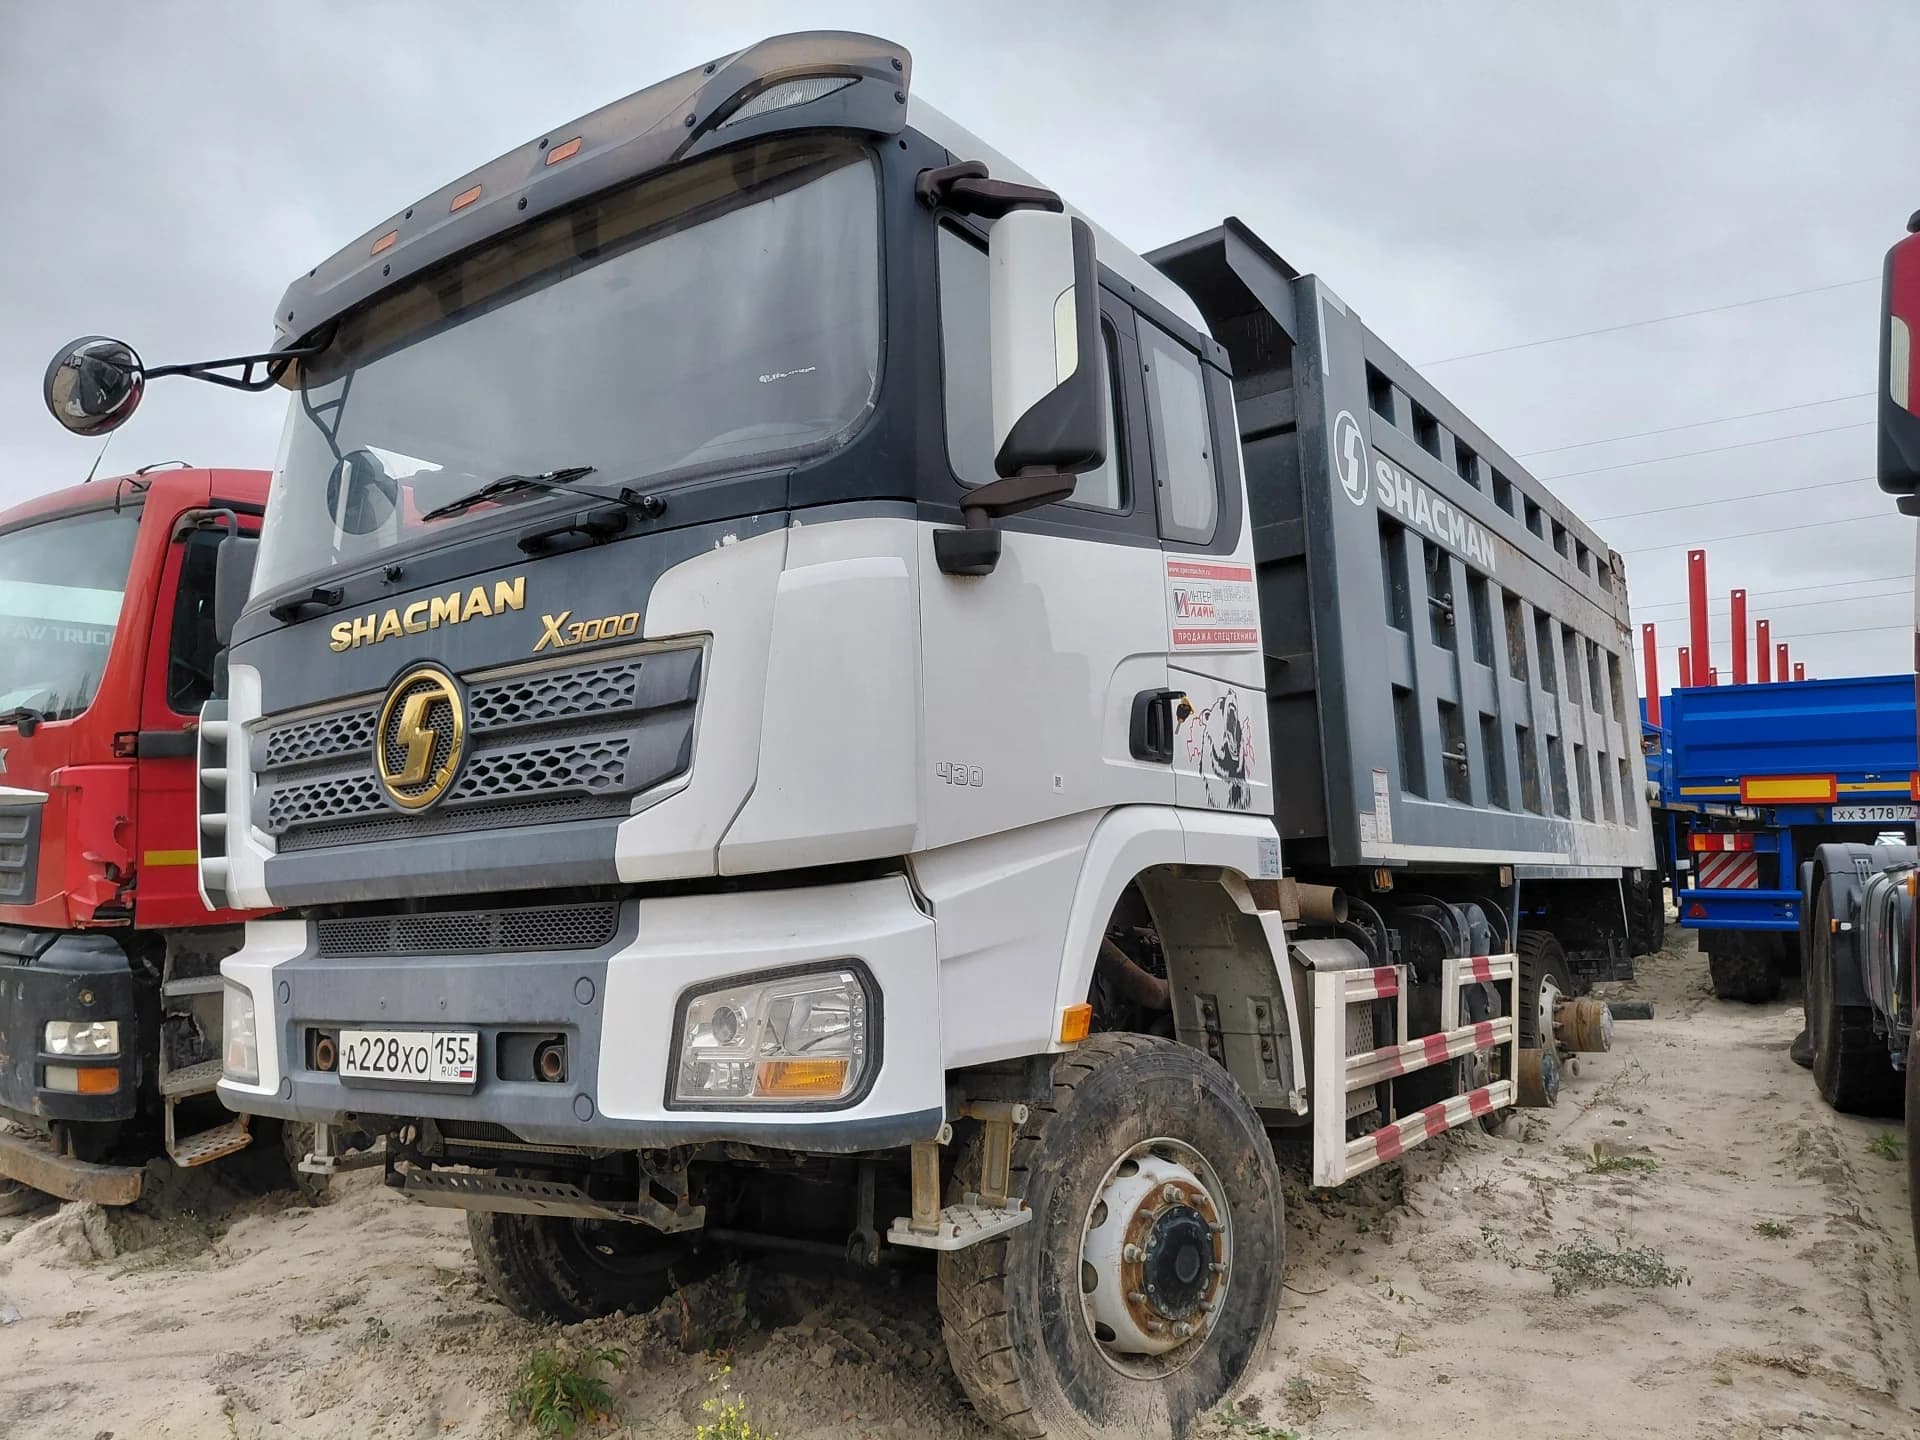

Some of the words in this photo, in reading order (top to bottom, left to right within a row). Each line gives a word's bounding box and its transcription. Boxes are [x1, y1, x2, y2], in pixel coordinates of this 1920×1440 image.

[1376, 460, 1496, 572] SHACMAN
[329, 576, 526, 652] SHACMAN
[533, 611, 640, 652] X3000
[1178, 632, 1211, 642] ПРОДАЖА
[1214, 632, 1257, 642] СПЕЦТЕХНИКИ
[935, 762, 984, 787] 430
[346, 1037, 429, 1074] А228ХО
[435, 1037, 470, 1065] 155
[441, 1066, 459, 1077] RUS
